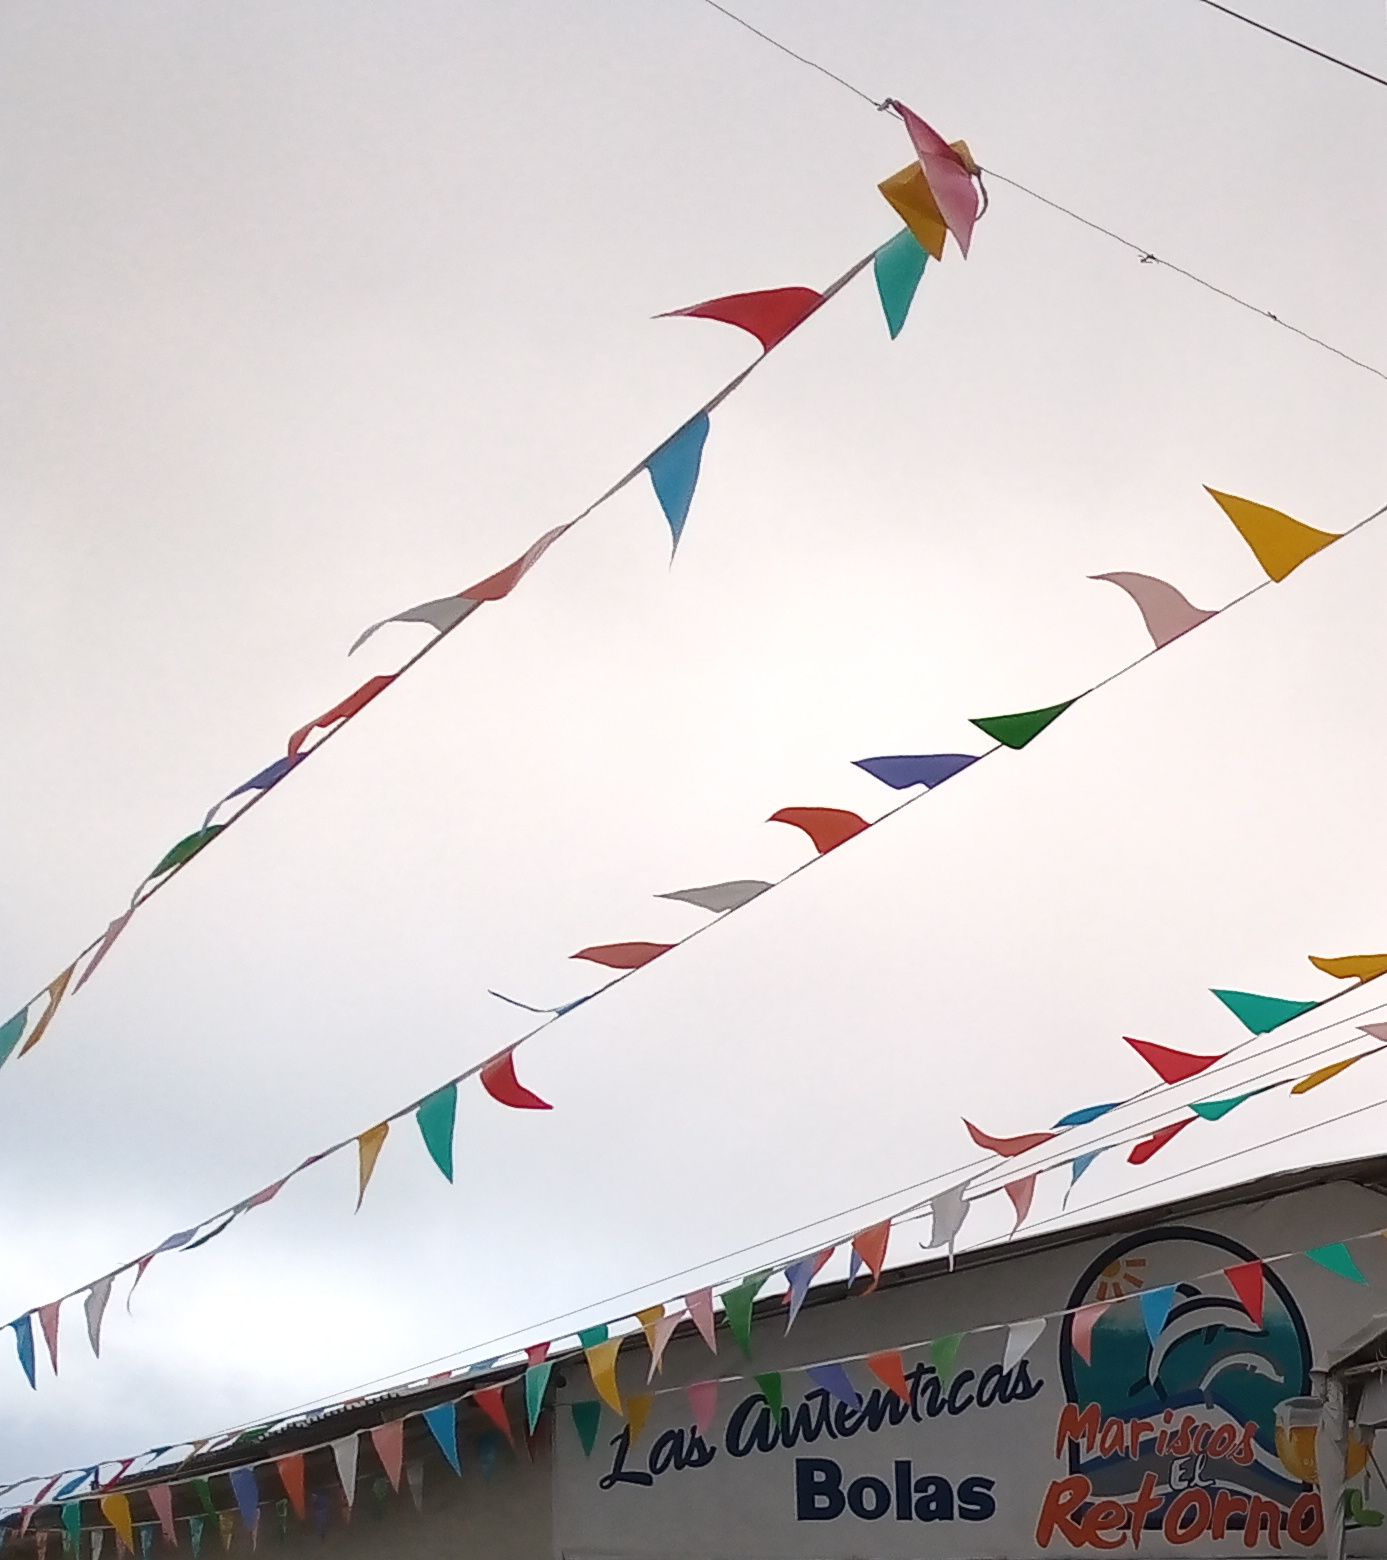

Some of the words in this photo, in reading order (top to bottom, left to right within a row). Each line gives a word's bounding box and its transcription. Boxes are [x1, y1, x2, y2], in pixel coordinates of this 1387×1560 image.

[598, 1422, 718, 1490] Las
[1055, 1401, 1260, 1467] Mariscos
[795, 1457, 996, 1522] Bolas
[1169, 1454, 1216, 1491] El
[1035, 1473, 1325, 1550] Retorno
